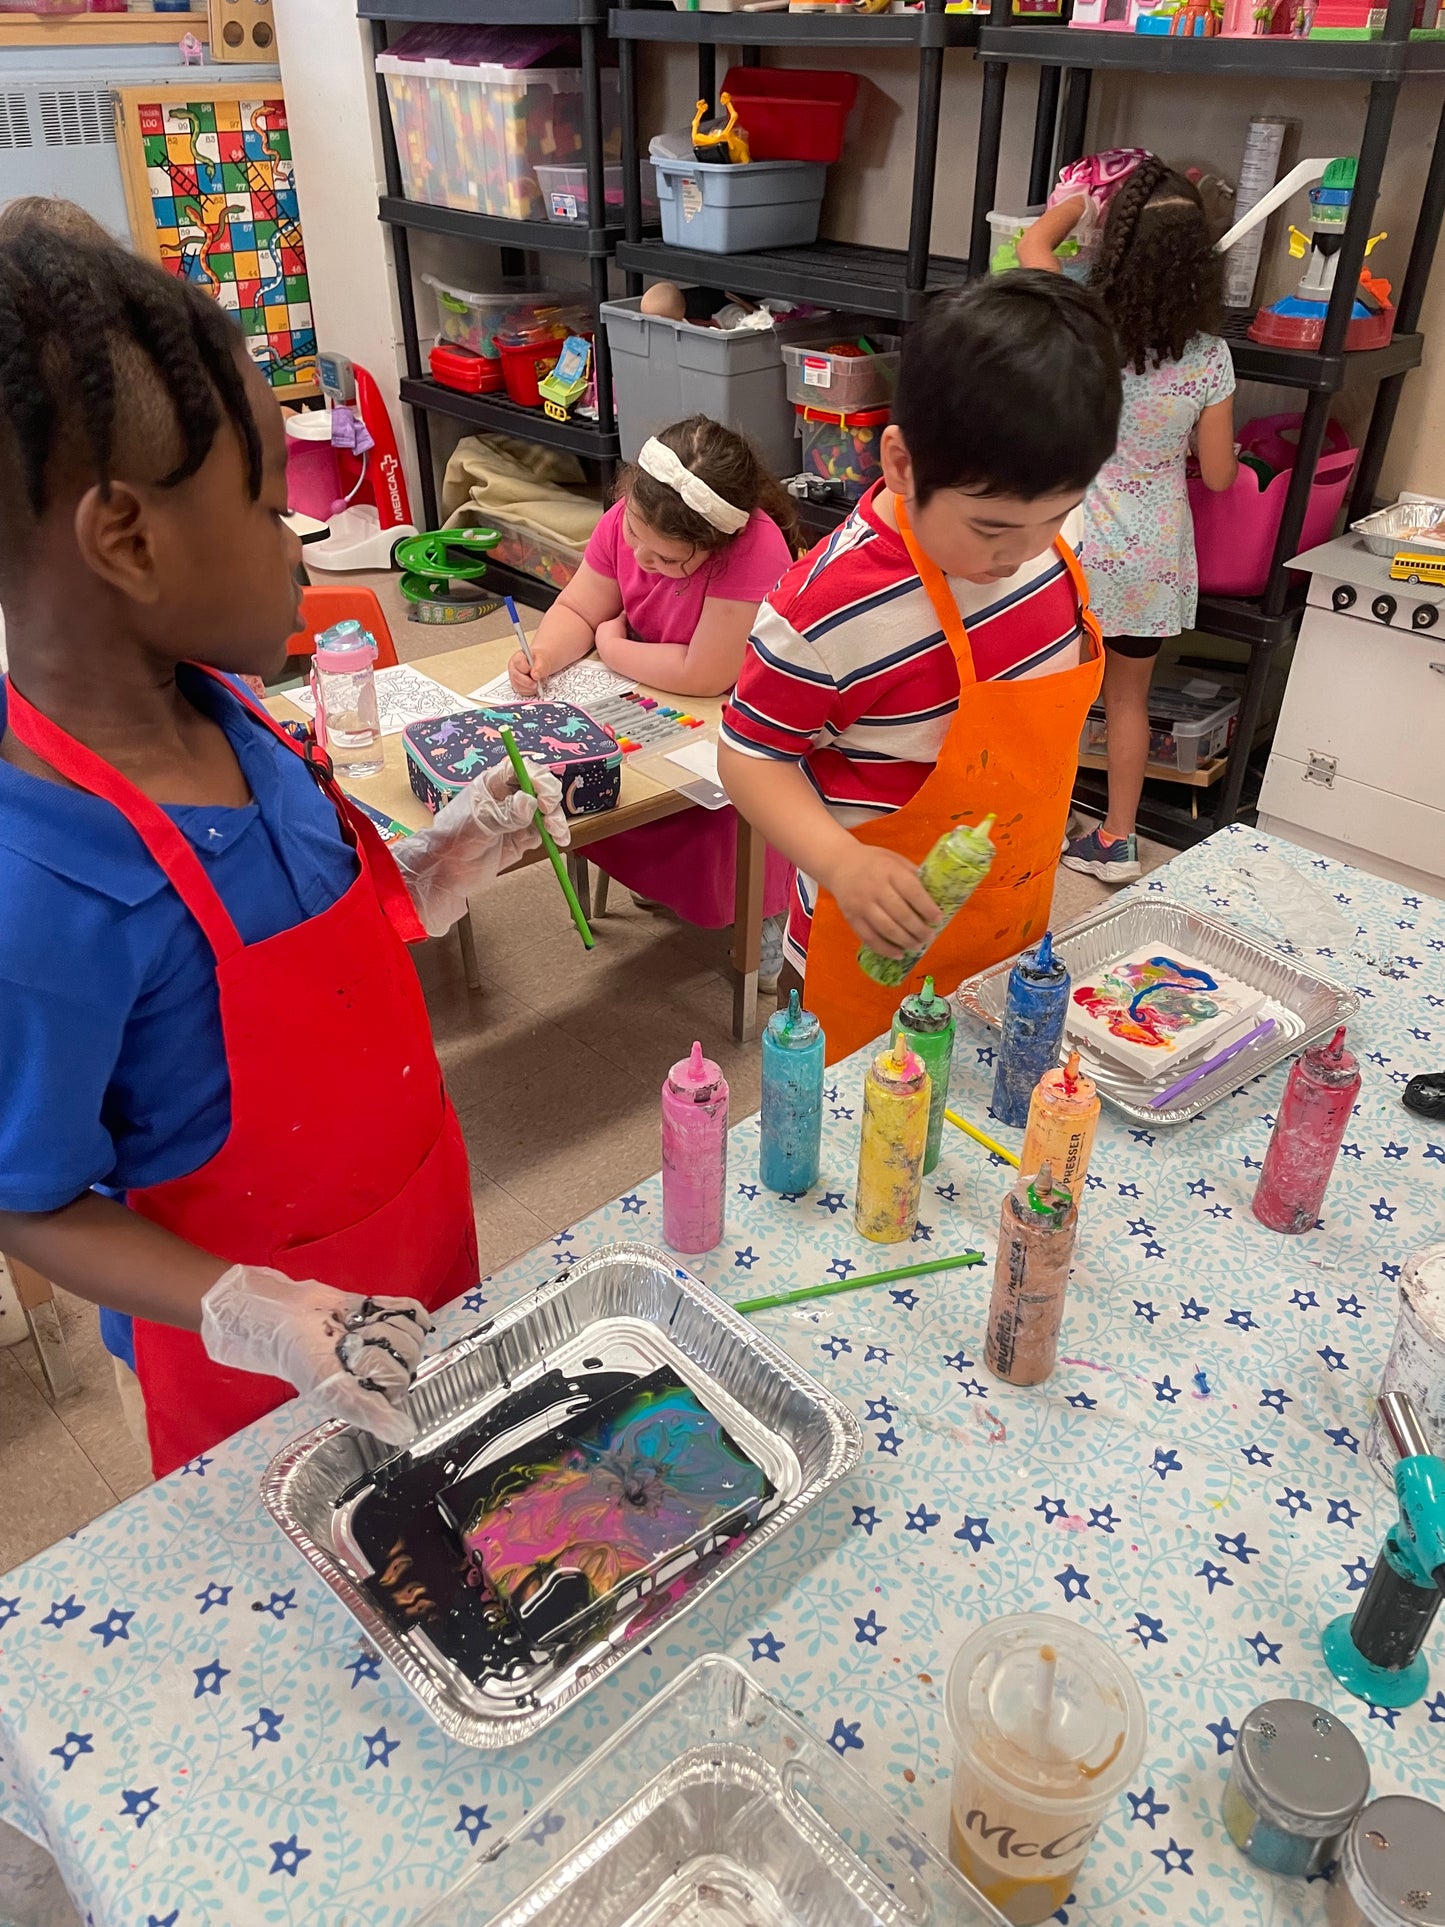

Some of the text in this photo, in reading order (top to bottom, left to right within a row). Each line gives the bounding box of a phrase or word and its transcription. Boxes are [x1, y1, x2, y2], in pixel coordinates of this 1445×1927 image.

[386, 471, 404, 521] MEDICAL
[1063, 1132, 1081, 1184] PRESSER
[965, 1809, 1099, 1859] McC
